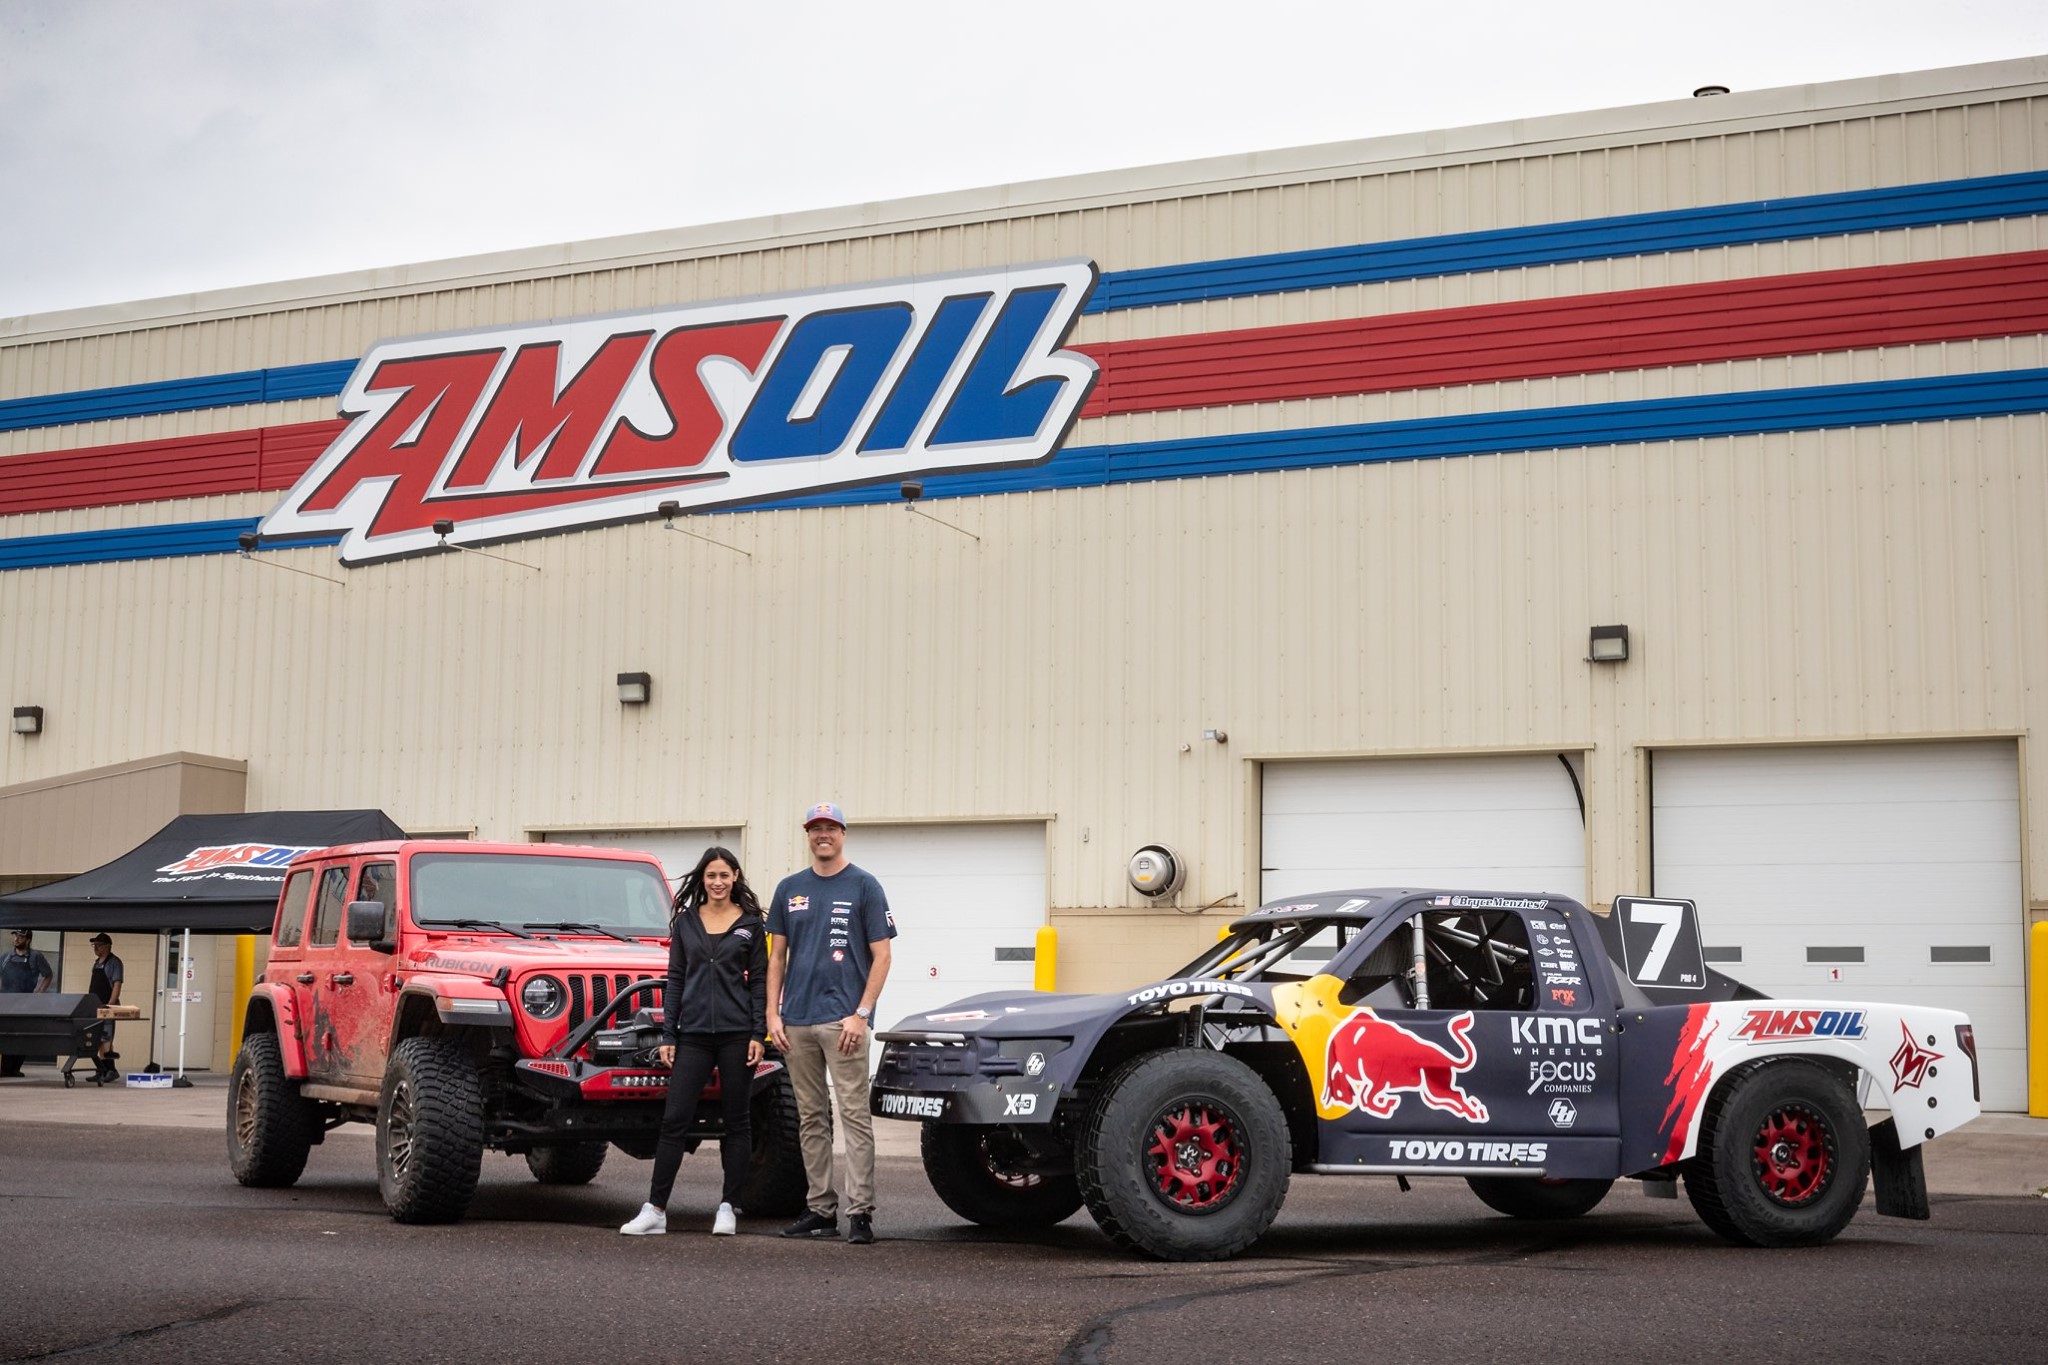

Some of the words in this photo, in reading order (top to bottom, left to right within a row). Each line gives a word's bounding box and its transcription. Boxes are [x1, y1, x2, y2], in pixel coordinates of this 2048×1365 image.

[298, 283, 1070, 539] AMSOIL
[1451, 895, 1548, 909] @BryceMenzies7
[1630, 902, 1684, 982] 7
[425, 956, 494, 974] RUBICON
[186, 970, 192, 979] 6
[929, 968, 937, 977] 3
[1691, 974, 1697, 983] 4
[1831, 968, 1839, 979] 1
[1545, 976, 1581, 986] RZR
[1128, 982, 1188, 1006] TOYO
[1189, 981, 1253, 997] TIRES
[1551, 989, 1576, 1003] FOX
[1736, 1010, 1864, 1041] AMSOIL
[1512, 1047, 1603, 1056] WHEELS
[1529, 1060, 1596, 1082] FOCUS
[1543, 1084, 1592, 1093] COMPANIES
[881, 1094, 907, 1114] TOYO
[906, 1096, 944, 1118] TIRES
[1389, 1140, 1465, 1160] TOYO
[1467, 1142, 1548, 1162] TIRES
